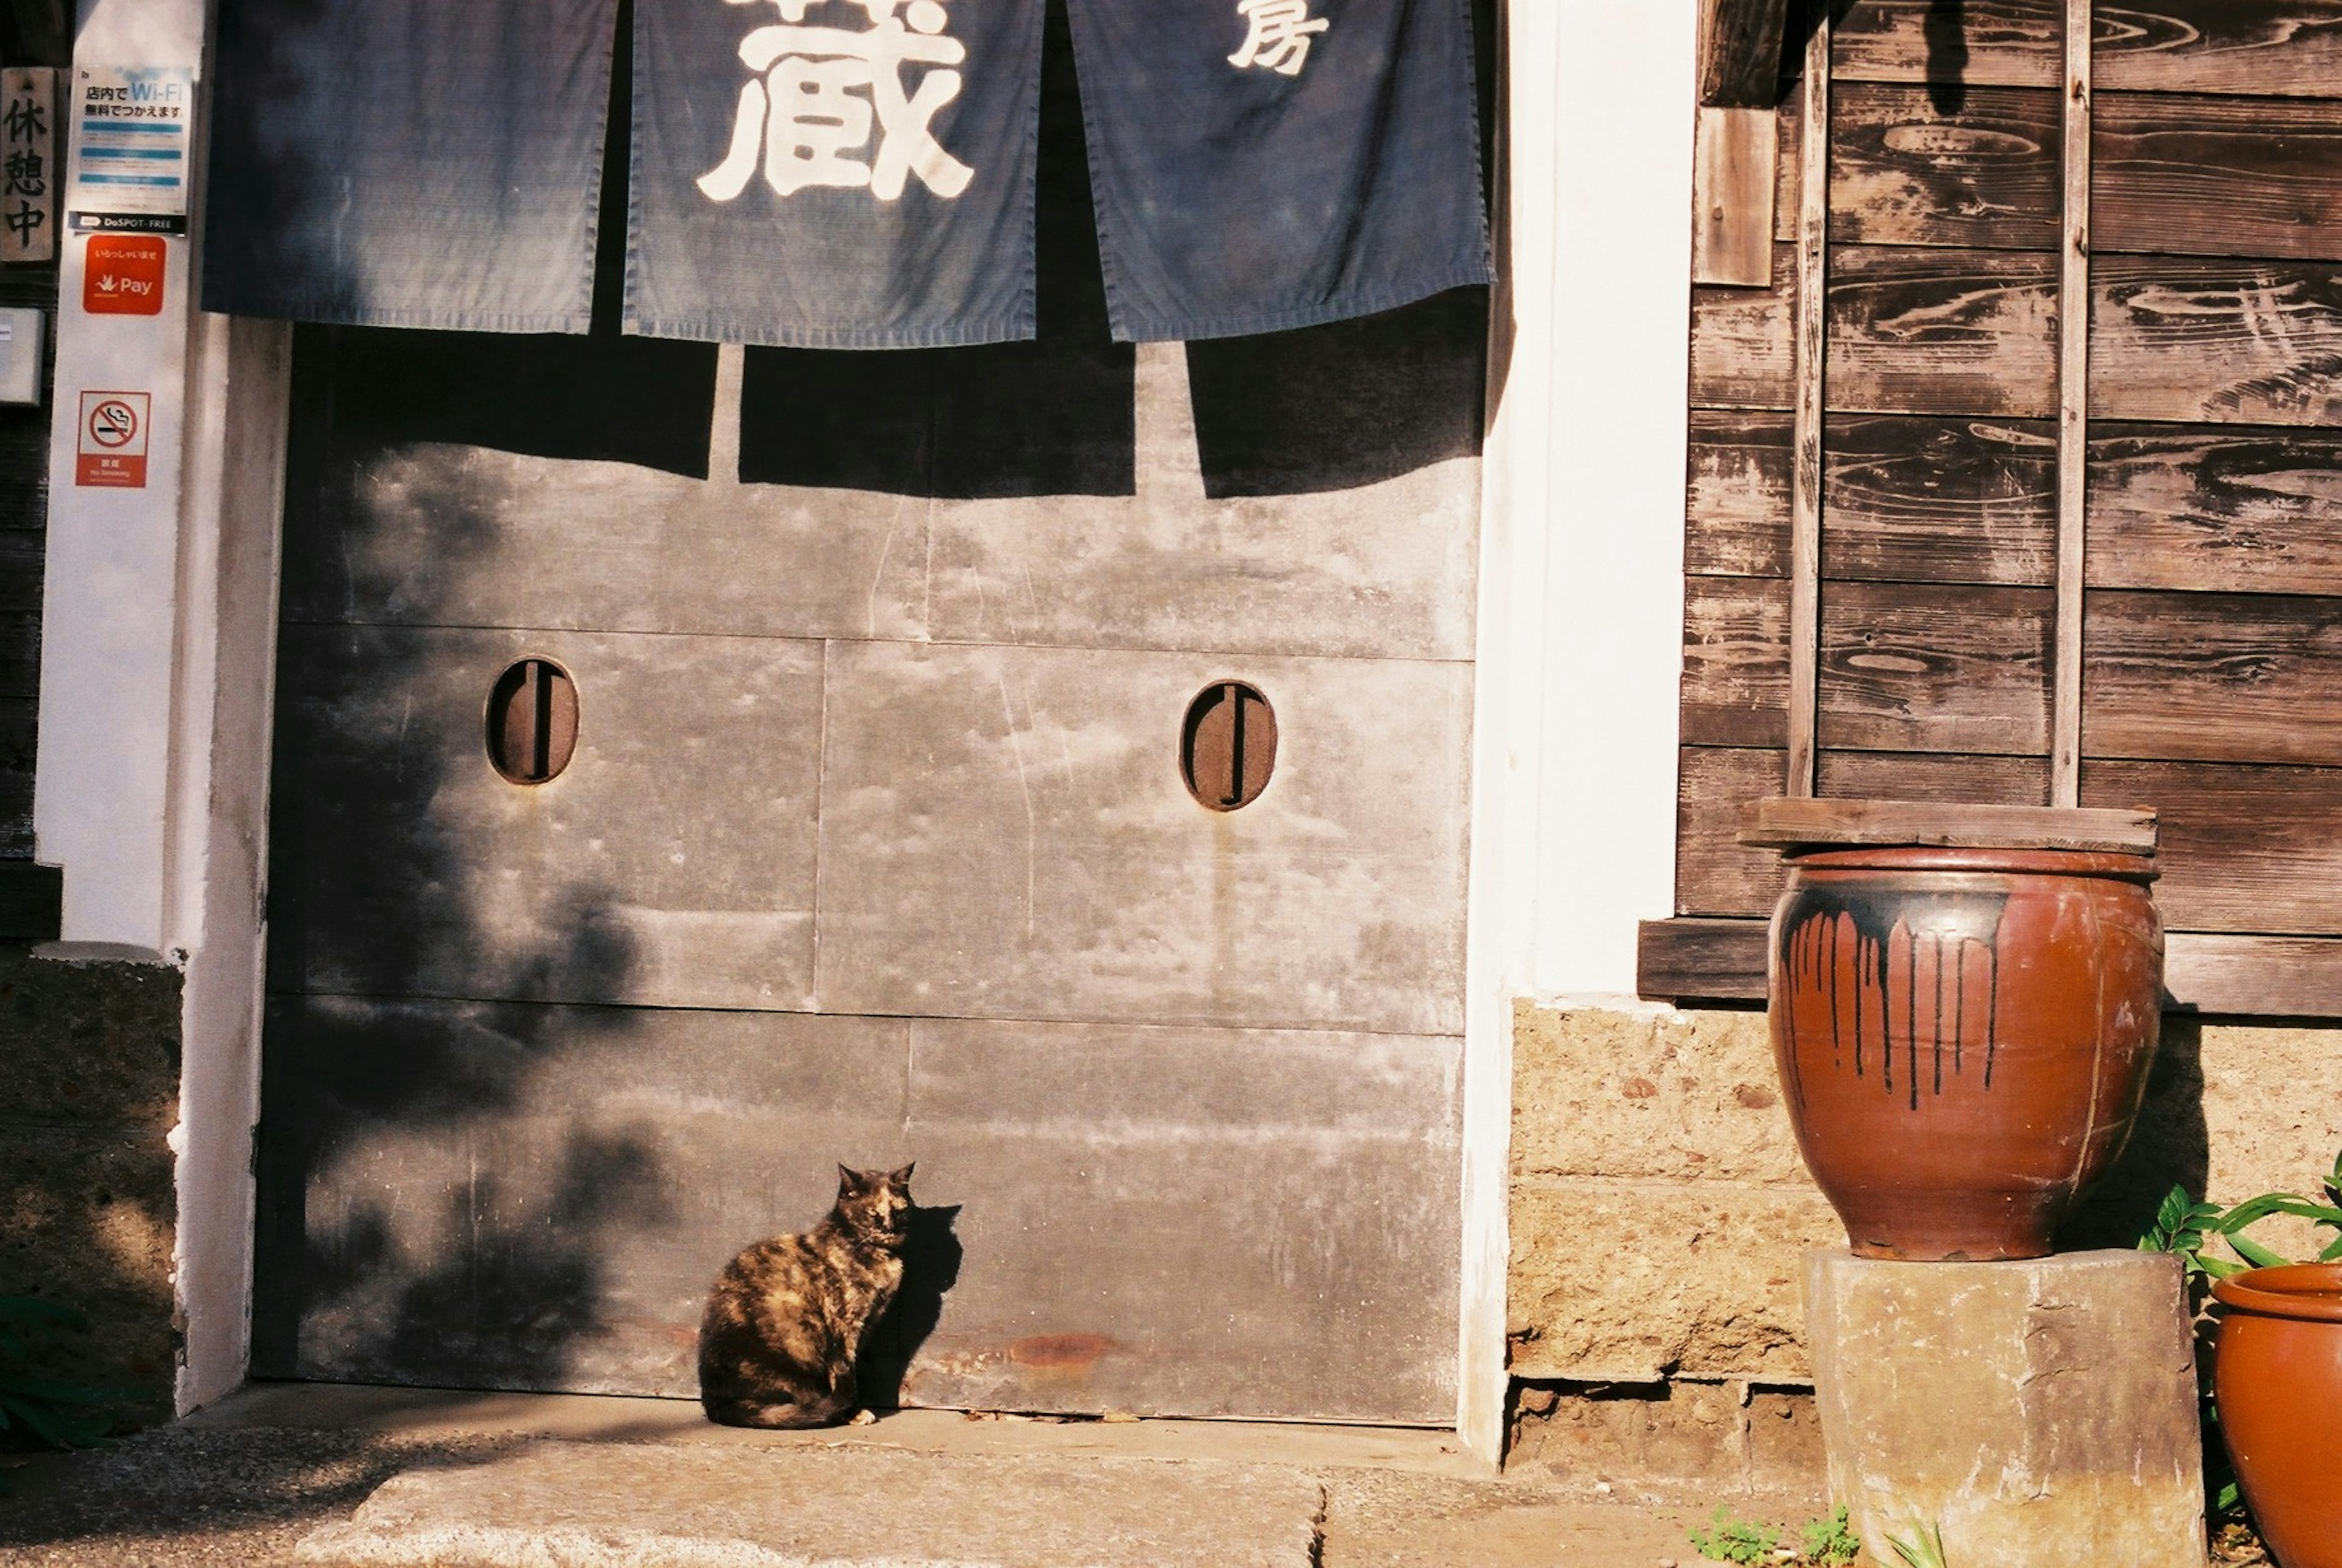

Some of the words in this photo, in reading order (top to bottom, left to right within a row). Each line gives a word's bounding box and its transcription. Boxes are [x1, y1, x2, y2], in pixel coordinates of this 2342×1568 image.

[1227, 0, 1330, 76] 房
[696, 0, 975, 202] 蔵
[4, 98, 48, 247] 休憩中
[121, 278, 153, 296] Pay
